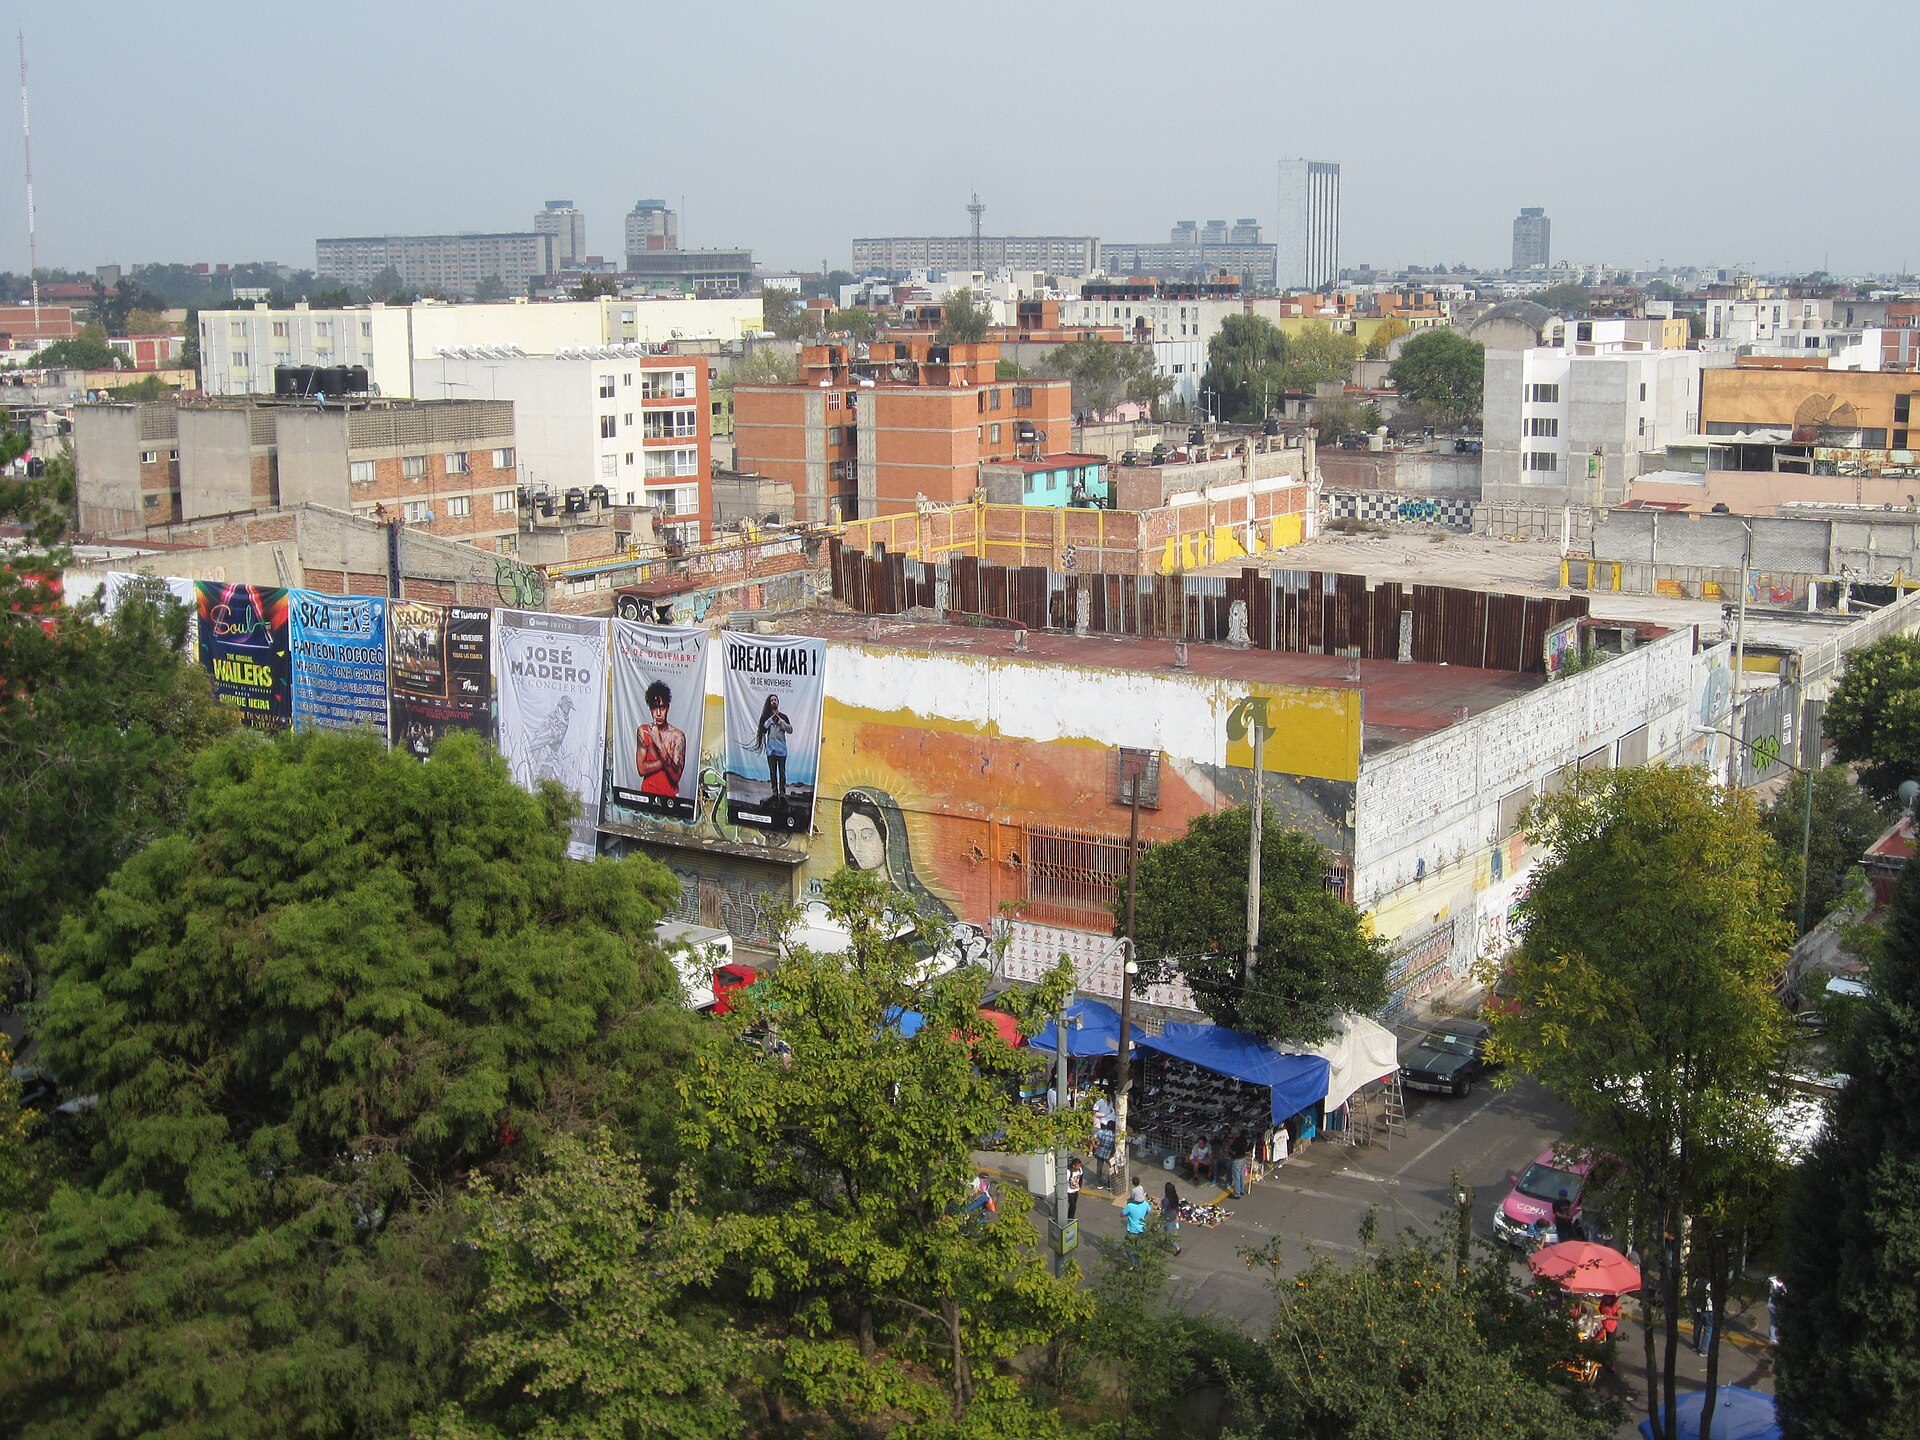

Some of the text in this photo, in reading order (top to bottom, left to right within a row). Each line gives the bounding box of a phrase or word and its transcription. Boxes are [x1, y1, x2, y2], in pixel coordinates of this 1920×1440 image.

[301, 601, 360, 632] SKATEX
[361, 606, 370, 633] 2018
[293, 639, 384, 664] PANTEÓN ROCOCÓ
[526, 646, 572, 665] JOSÉ
[633, 648, 644, 657] DE
[648, 650, 697, 662] DICIEMBRE
[730, 643, 816, 676] DREAD MAR I
[212, 658, 273, 688] WAILERS
[332, 666, 353, 679] ZONA
[511, 661, 591, 684] MADERO
[756, 677, 763, 686] DE
[764, 678, 792, 688] NOVIEMBRE
[528, 679, 592, 694] CONCIERTO
[1517, 1203, 1548, 1216] CDMX
